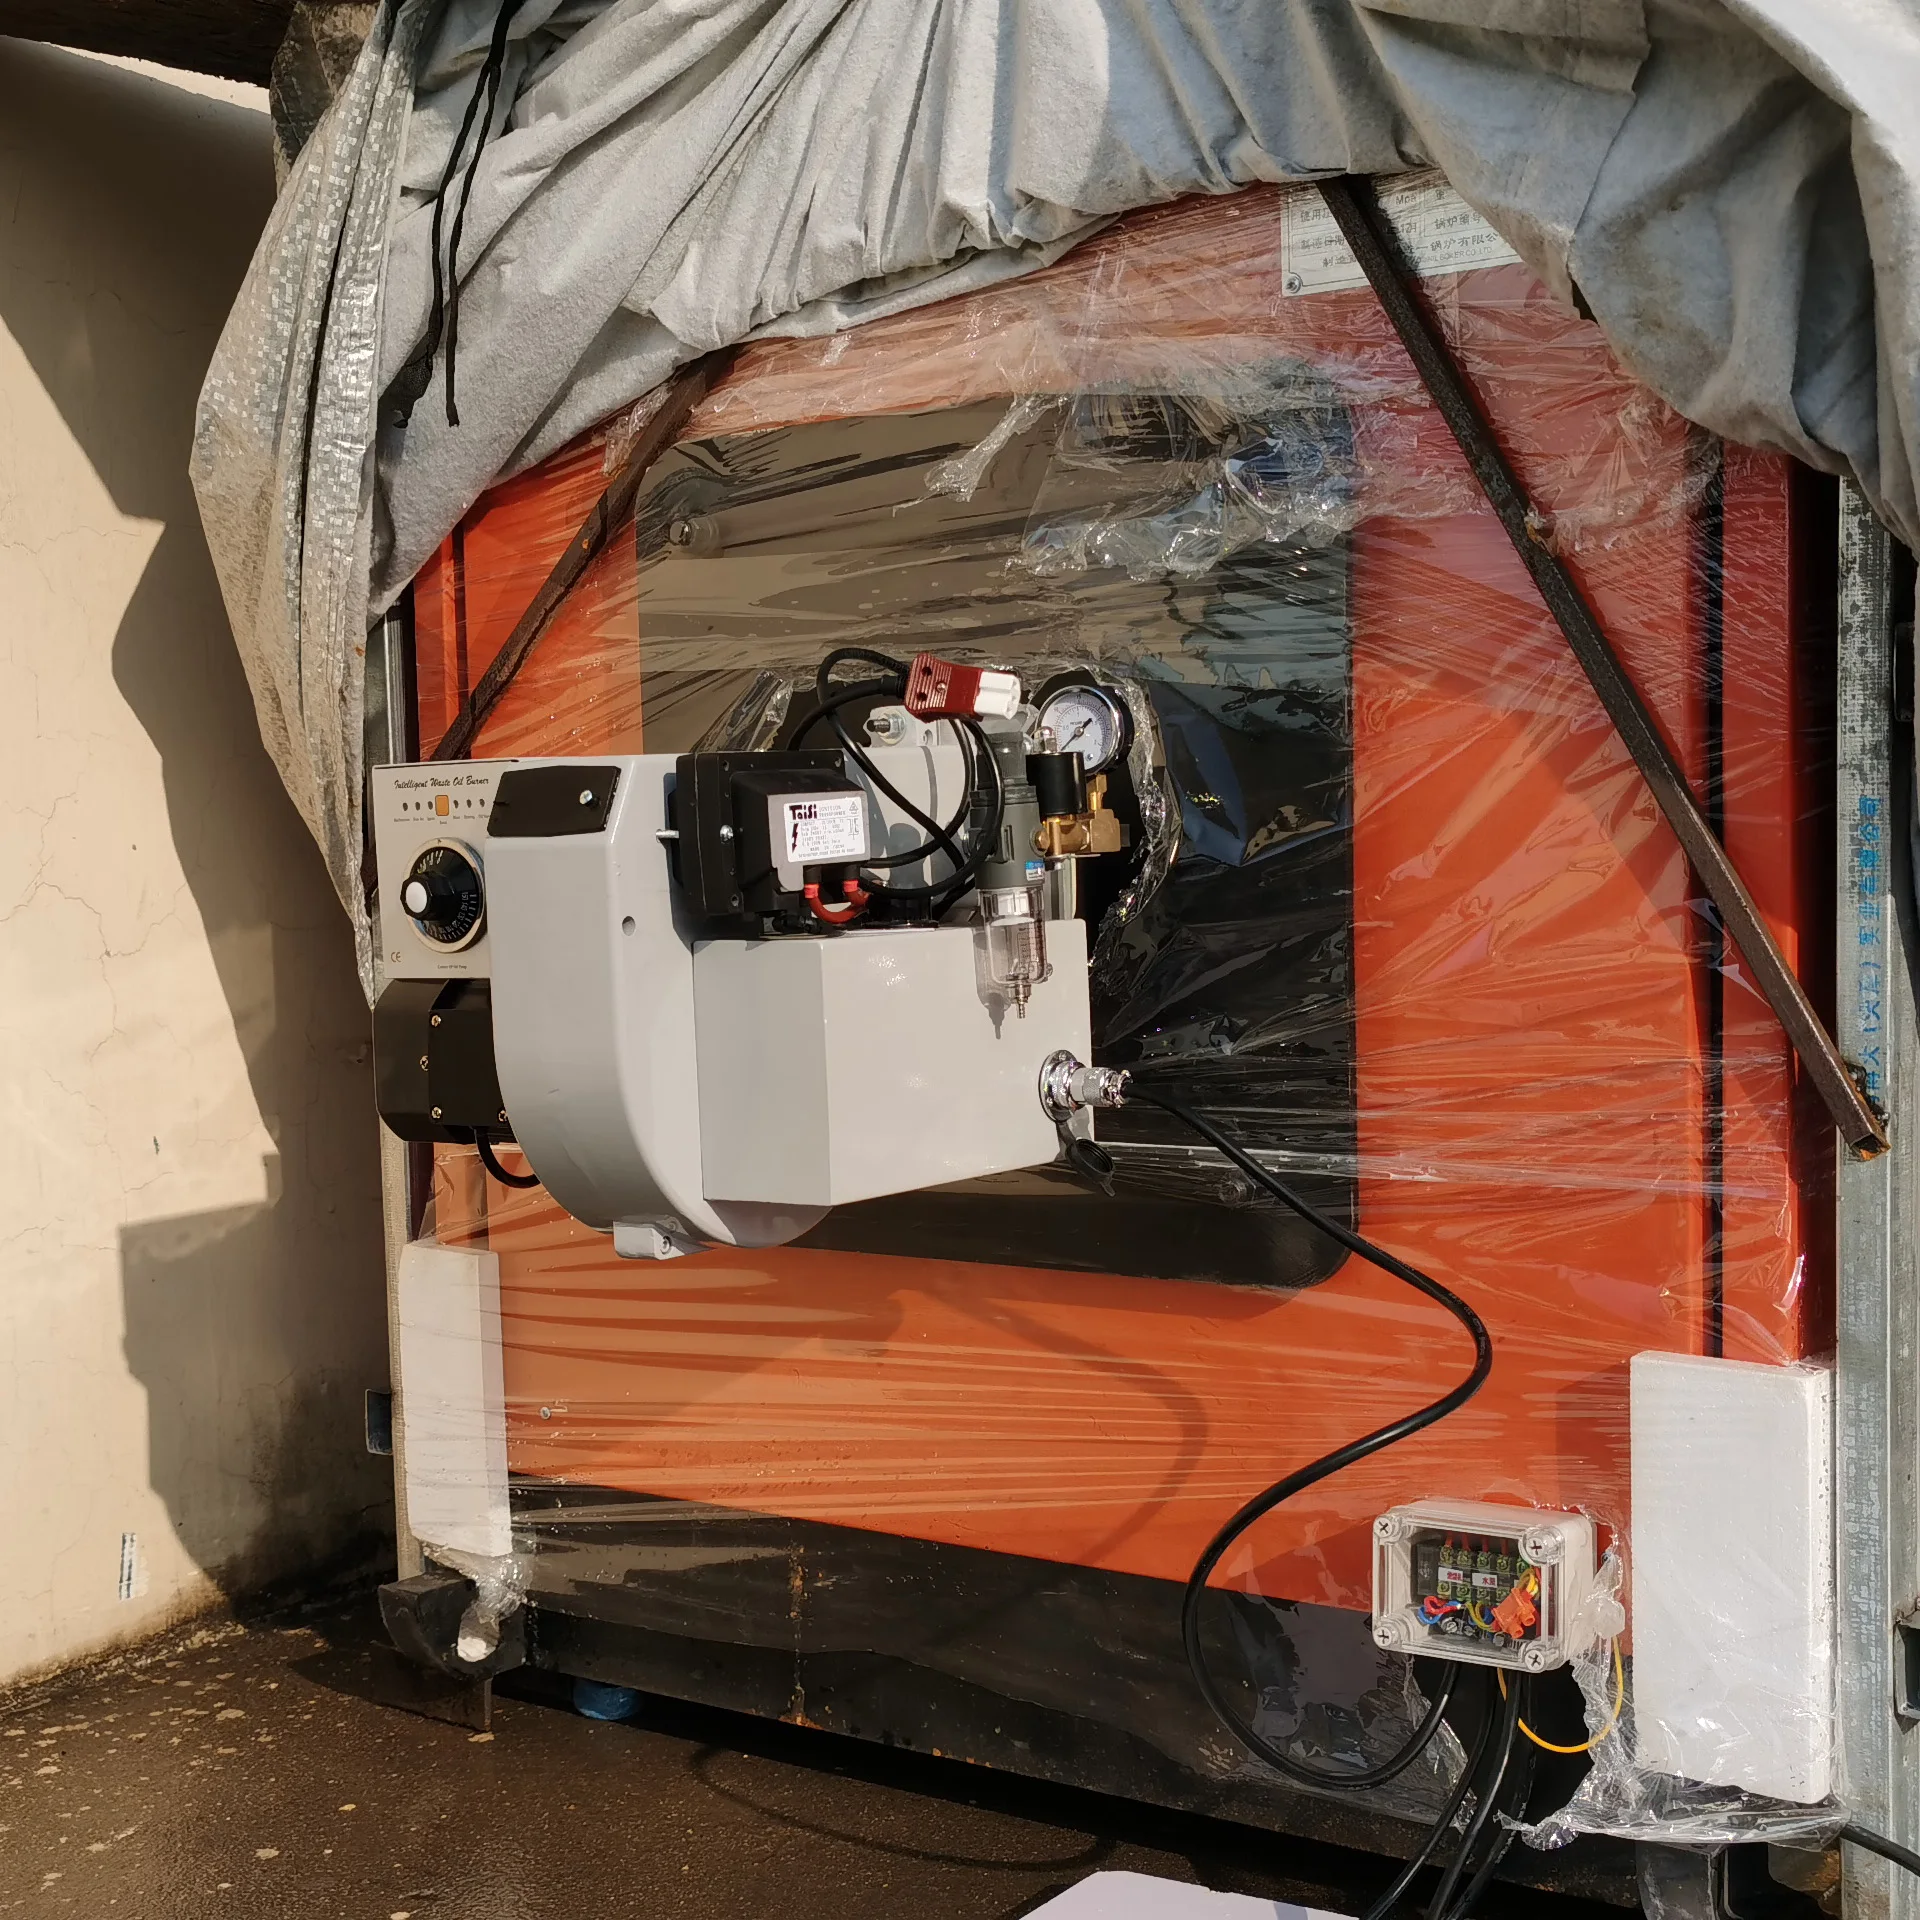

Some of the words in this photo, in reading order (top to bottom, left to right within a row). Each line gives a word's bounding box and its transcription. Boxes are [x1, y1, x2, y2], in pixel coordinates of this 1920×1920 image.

[430, 777, 451, 787] Waste
[452, 776, 465, 786] Oil
[466, 775, 489, 785] Burner
